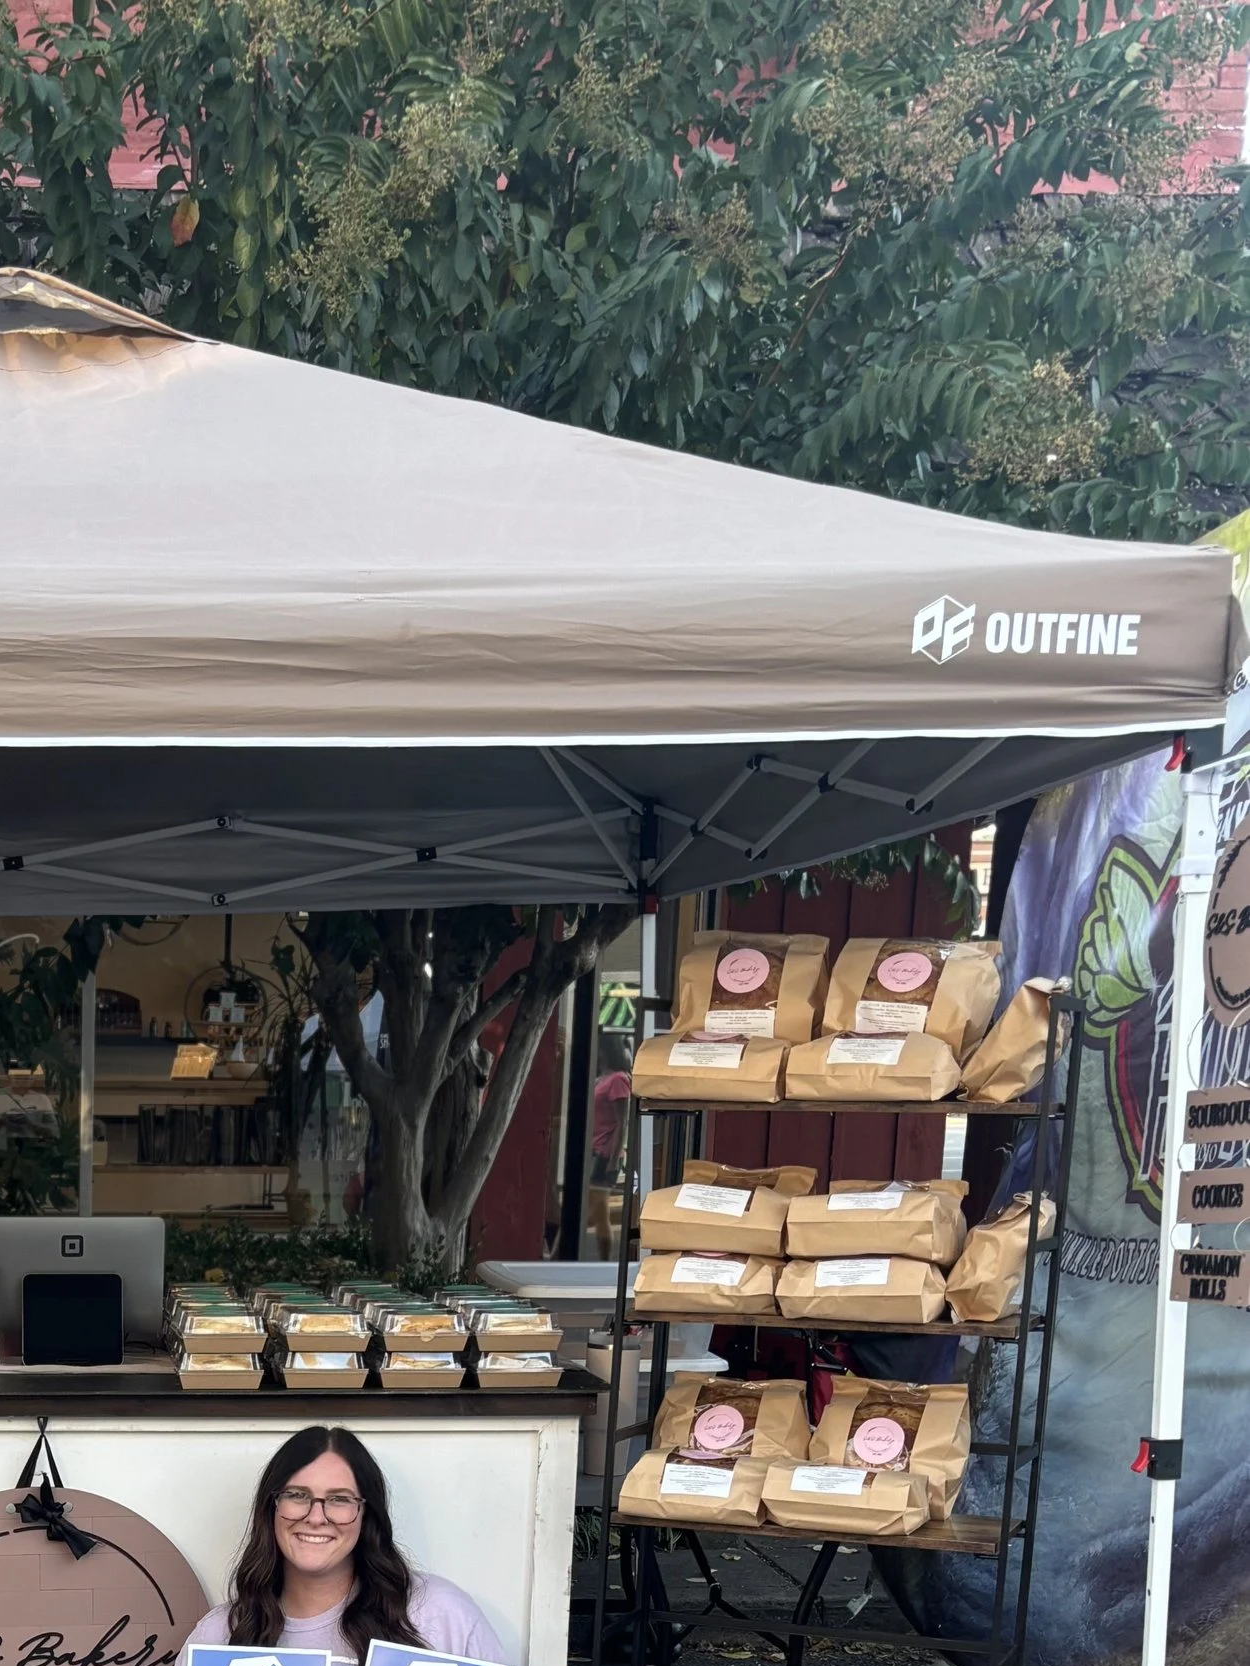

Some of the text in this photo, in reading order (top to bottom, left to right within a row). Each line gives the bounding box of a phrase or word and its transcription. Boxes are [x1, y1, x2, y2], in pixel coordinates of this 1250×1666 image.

[985, 611, 1142, 656] OUTFINE
[1192, 1183, 1244, 1209] COOKIES
[1180, 1253, 1242, 1278] CINNAMON
[1188, 1277, 1227, 1301] ROLLS
